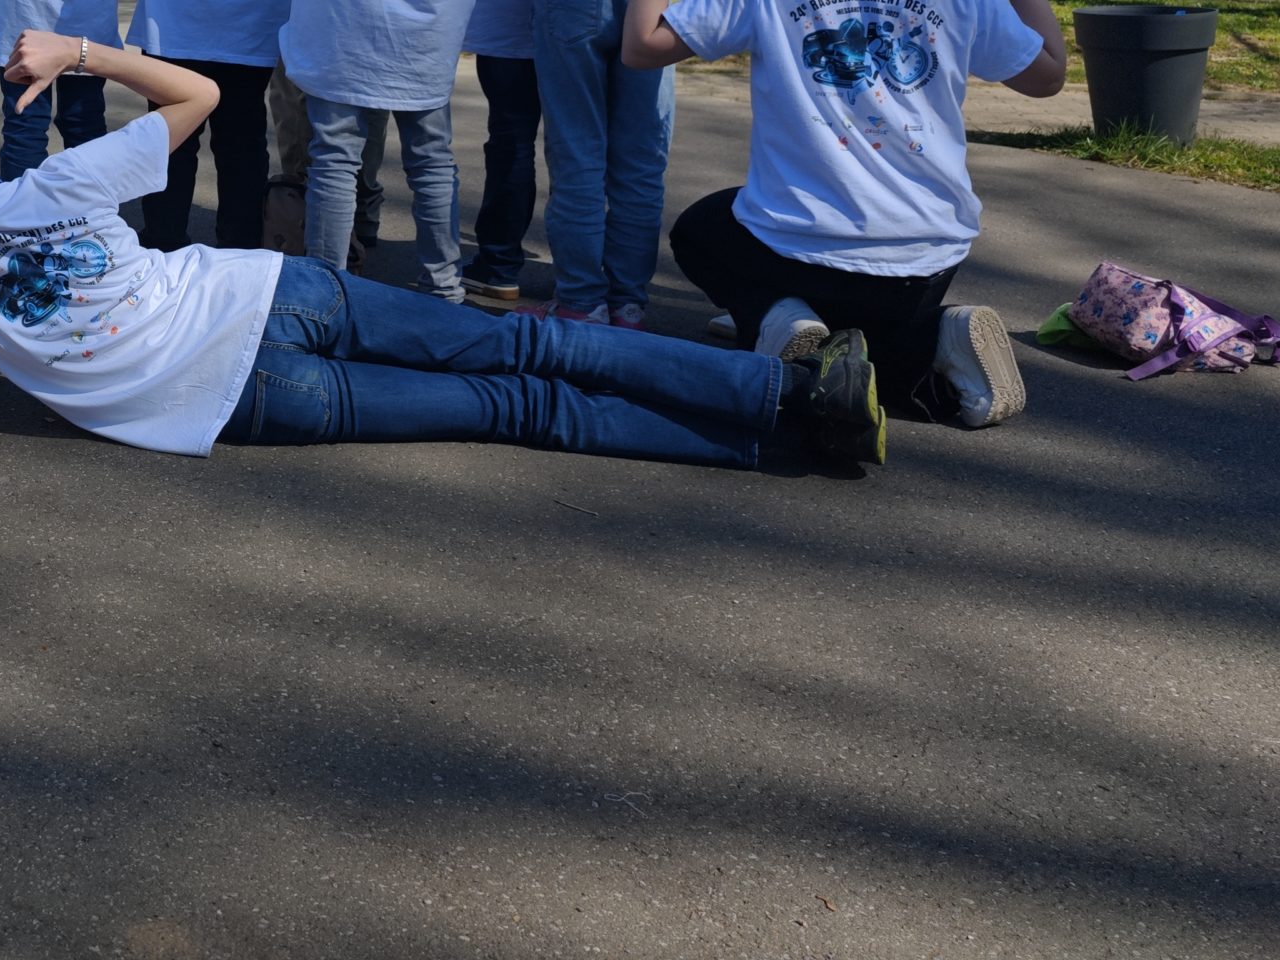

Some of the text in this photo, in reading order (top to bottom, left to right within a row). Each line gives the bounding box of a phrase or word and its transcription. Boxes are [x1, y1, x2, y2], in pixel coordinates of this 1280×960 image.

[790, 3, 807, 22] 24e
[926, 10, 944, 29] CCE
[45, 220, 65, 235] DES
